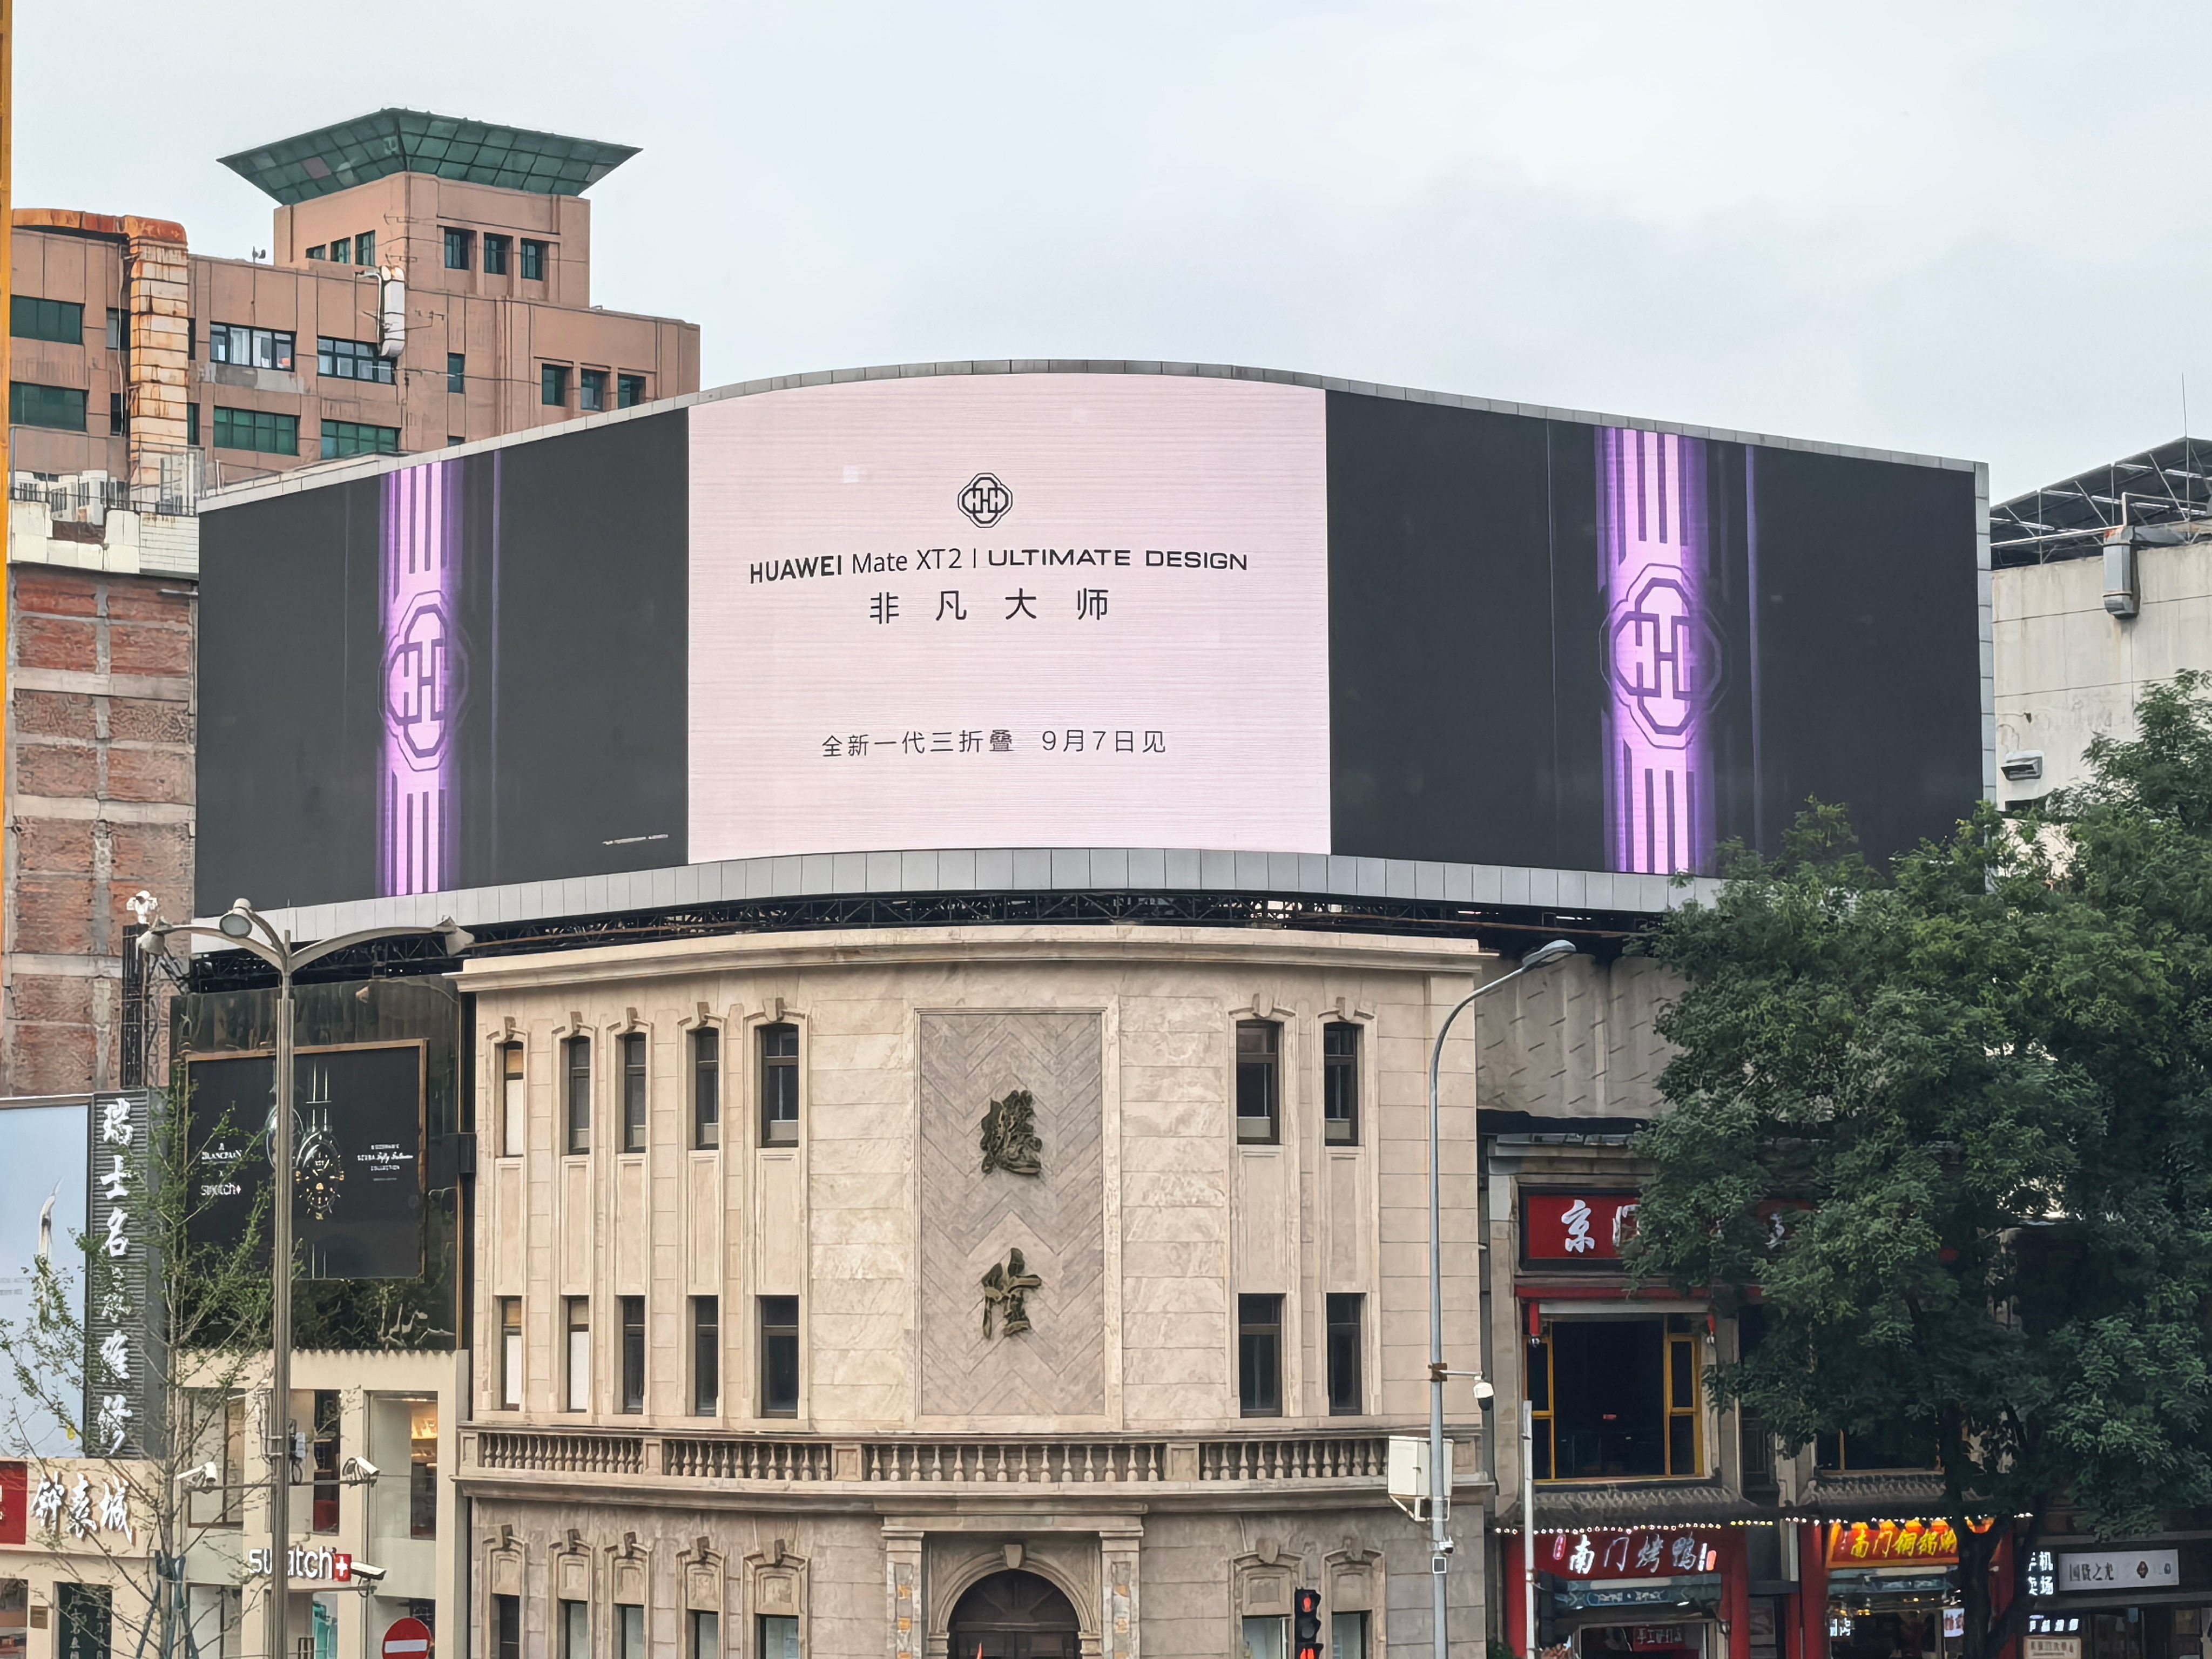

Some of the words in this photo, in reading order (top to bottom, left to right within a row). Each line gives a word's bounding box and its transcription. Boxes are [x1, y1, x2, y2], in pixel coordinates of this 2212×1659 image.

[750, 555, 842, 584] HUAWEI
[853, 552, 908, 574] Mate
[916, 548, 962, 570] XT2
[988, 548, 1131, 567] ULTIMATE
[1145, 550, 1247, 571] DESIGN
[869, 587, 1109, 624] 非凡大师
[822, 729, 1015, 757] 全新一代三折叠
[1041, 729, 1166, 754] 9月7日见
[1569, 1532, 1697, 1574] 南门烤鸭
